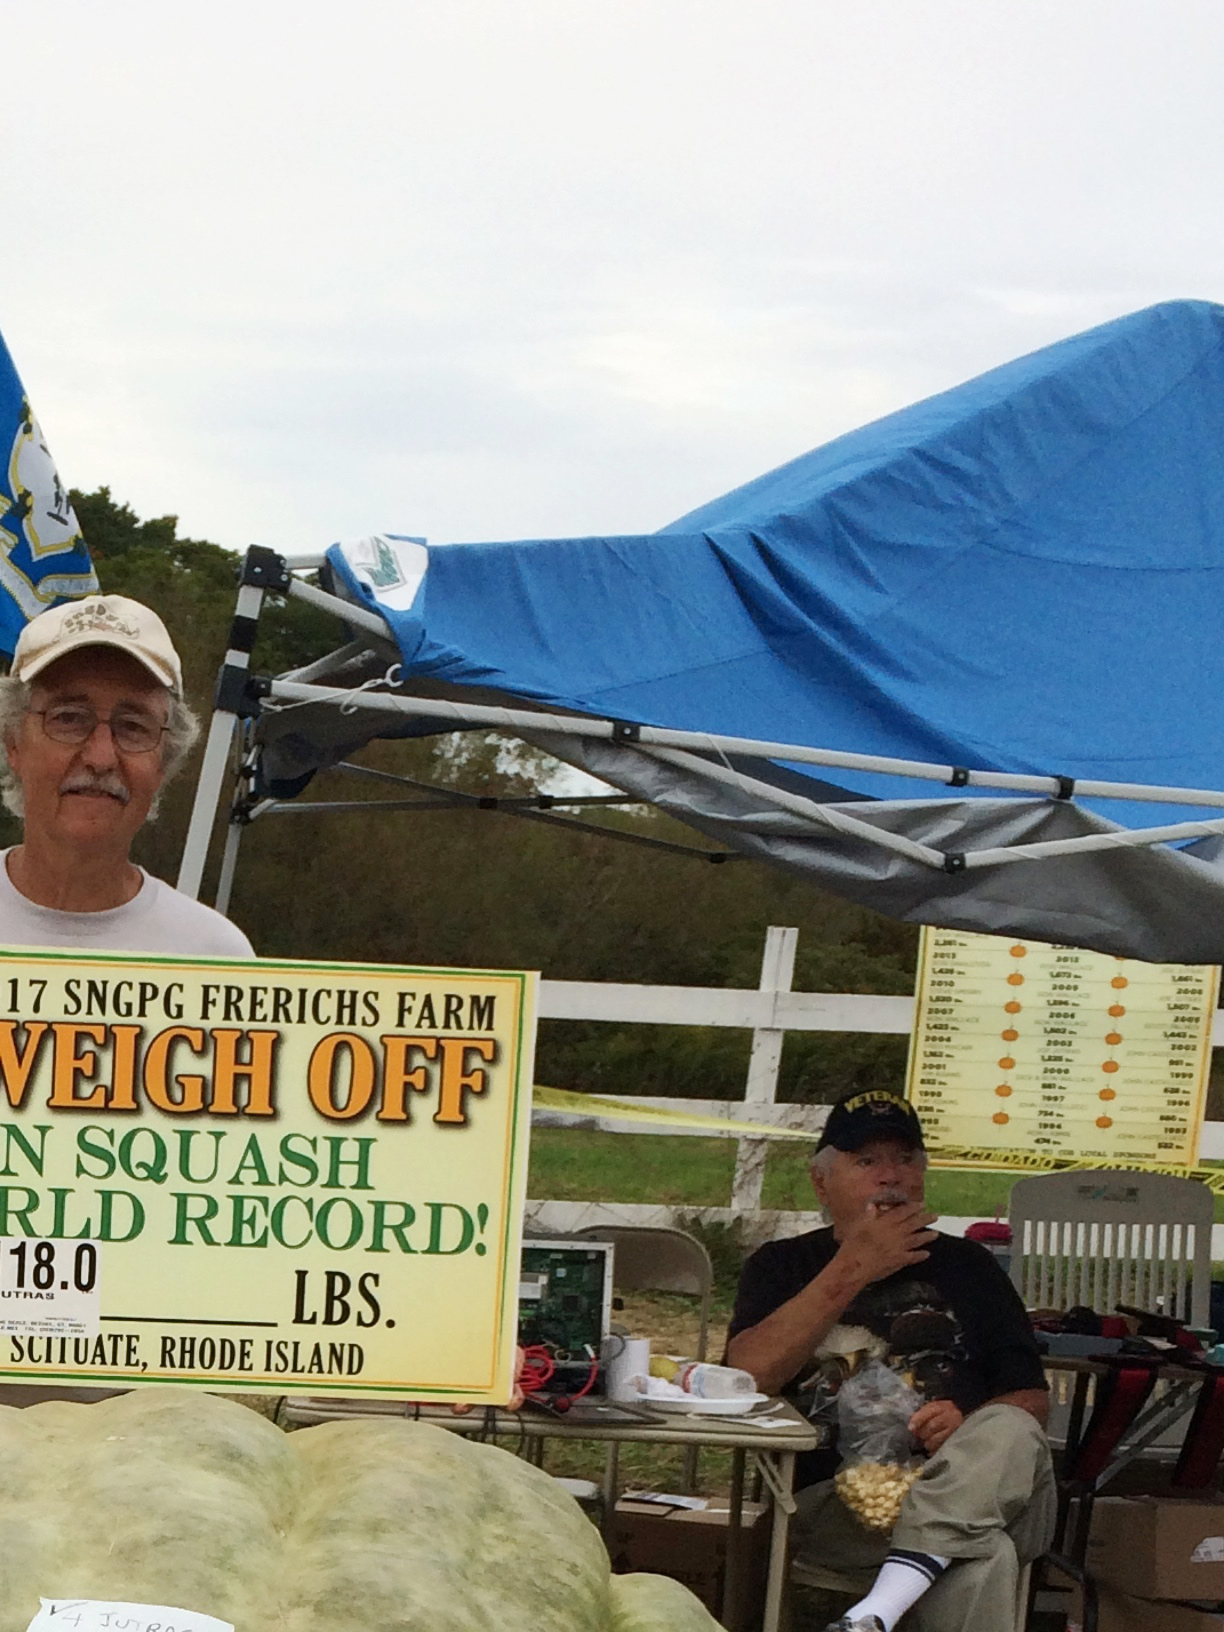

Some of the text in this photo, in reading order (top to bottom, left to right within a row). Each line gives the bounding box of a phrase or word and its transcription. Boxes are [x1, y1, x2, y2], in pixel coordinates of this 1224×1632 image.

[63, 978, 185, 1020] SNGPG
[200, 983, 381, 1028] FRERICHS
[395, 991, 498, 1032] FARM
[306, 1030, 498, 1125] OFF
[74, 1124, 380, 1191] SQUASH
[166, 1190, 490, 1258] RECORD!
[291, 1269, 397, 1329] LBS.
[10, 1333, 148, 1374] SCITUATE,
[159, 1335, 255, 1372] RHODE
[264, 1340, 365, 1377] ISLAND
